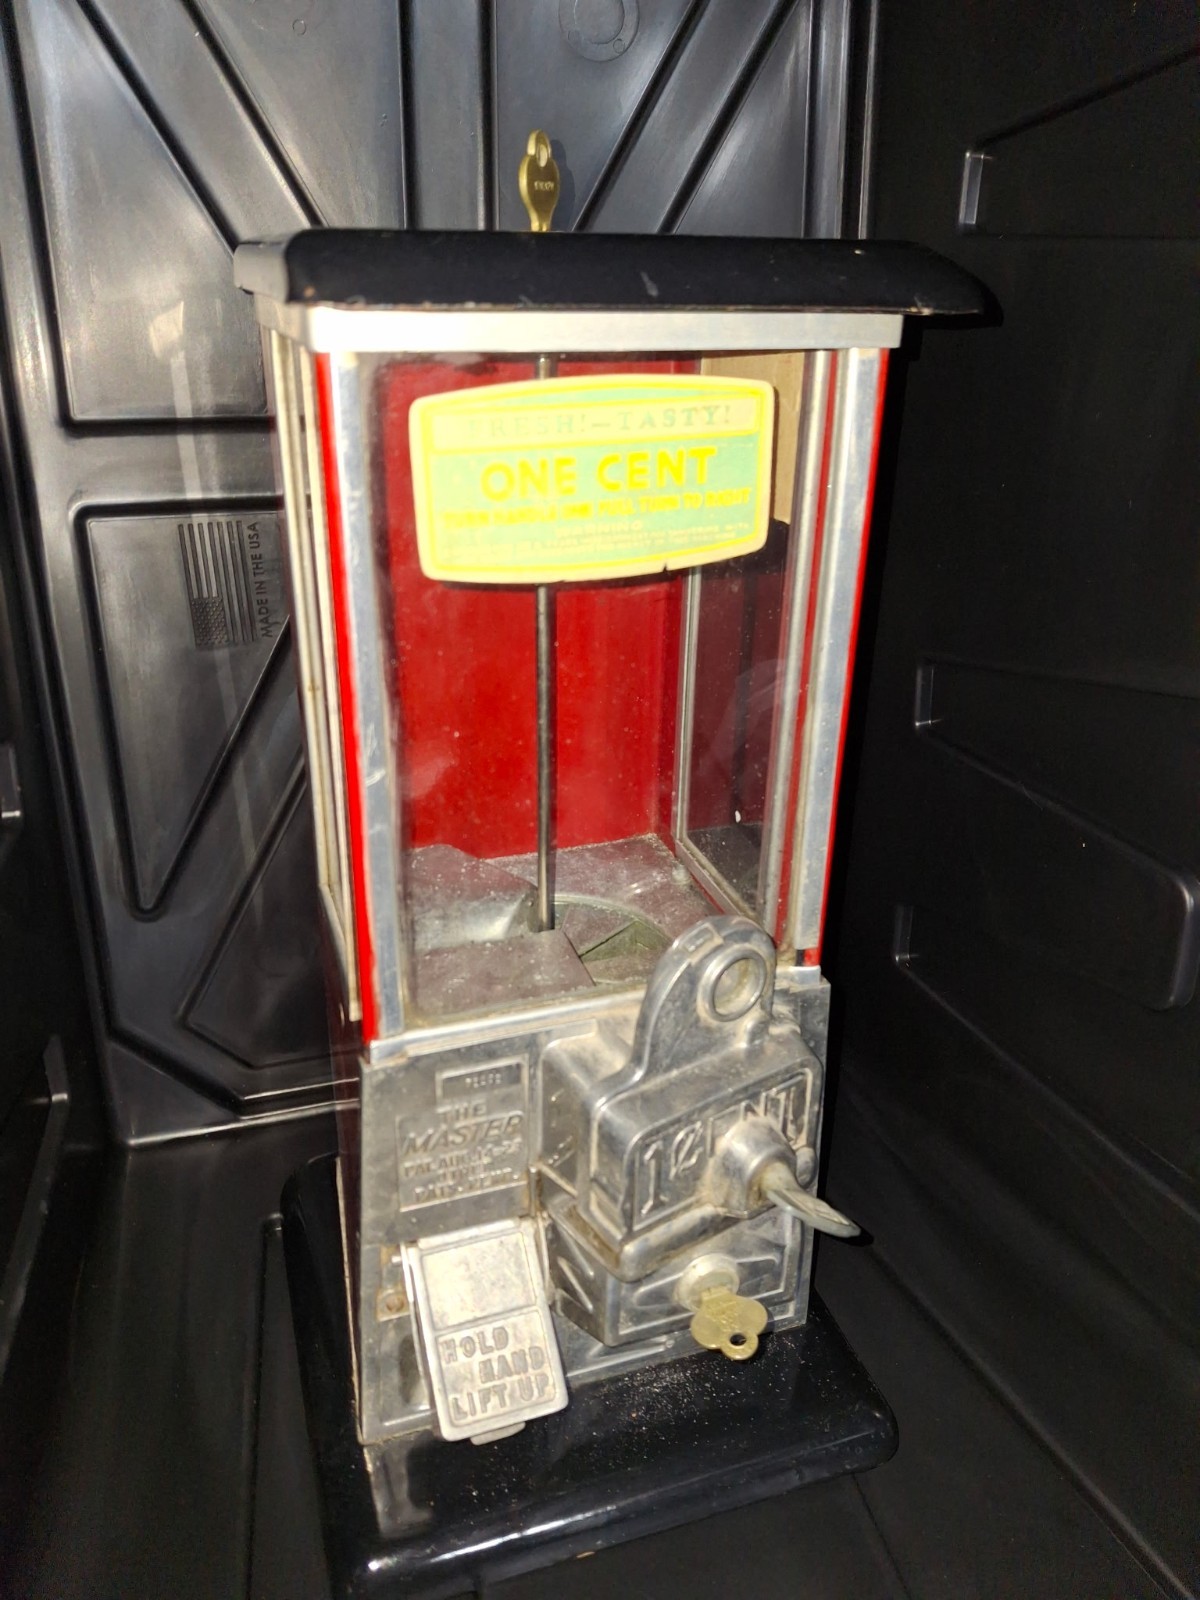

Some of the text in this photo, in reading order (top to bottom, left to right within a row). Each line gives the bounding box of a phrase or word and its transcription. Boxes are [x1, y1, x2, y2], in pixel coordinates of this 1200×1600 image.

[480, 446, 717, 502] ONE CENT
[683, 491, 703, 509] TO
[247, 521, 273, 638] MADE IN THE USA
[436, 1100, 487, 1121] THE
[404, 1110, 524, 1154] MASTER
[440, 1326, 509, 1364] HOLD
[479, 1346, 545, 1384] HAND
[451, 1374, 549, 1421] LIFT UP
